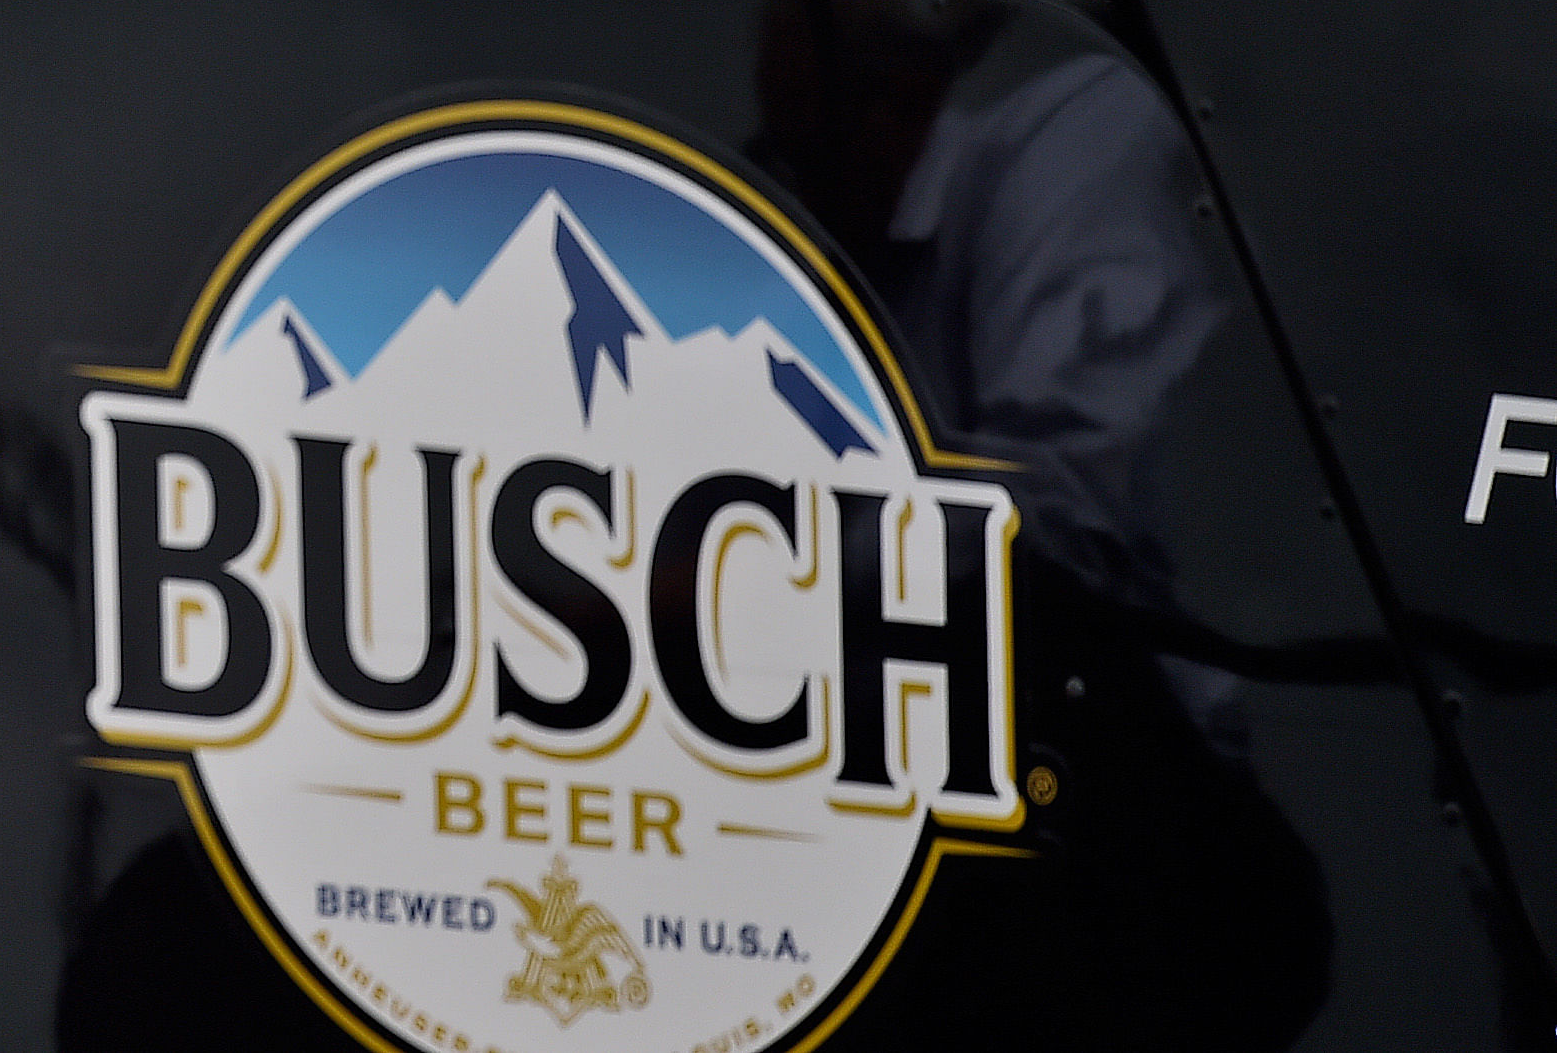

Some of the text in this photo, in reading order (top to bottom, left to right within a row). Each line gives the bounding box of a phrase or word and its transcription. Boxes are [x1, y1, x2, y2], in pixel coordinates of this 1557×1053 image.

[95, 412, 1015, 812] BUSCH
[433, 769, 684, 857] BEER
[315, 882, 811, 963] BREWED IN U.S.A.
